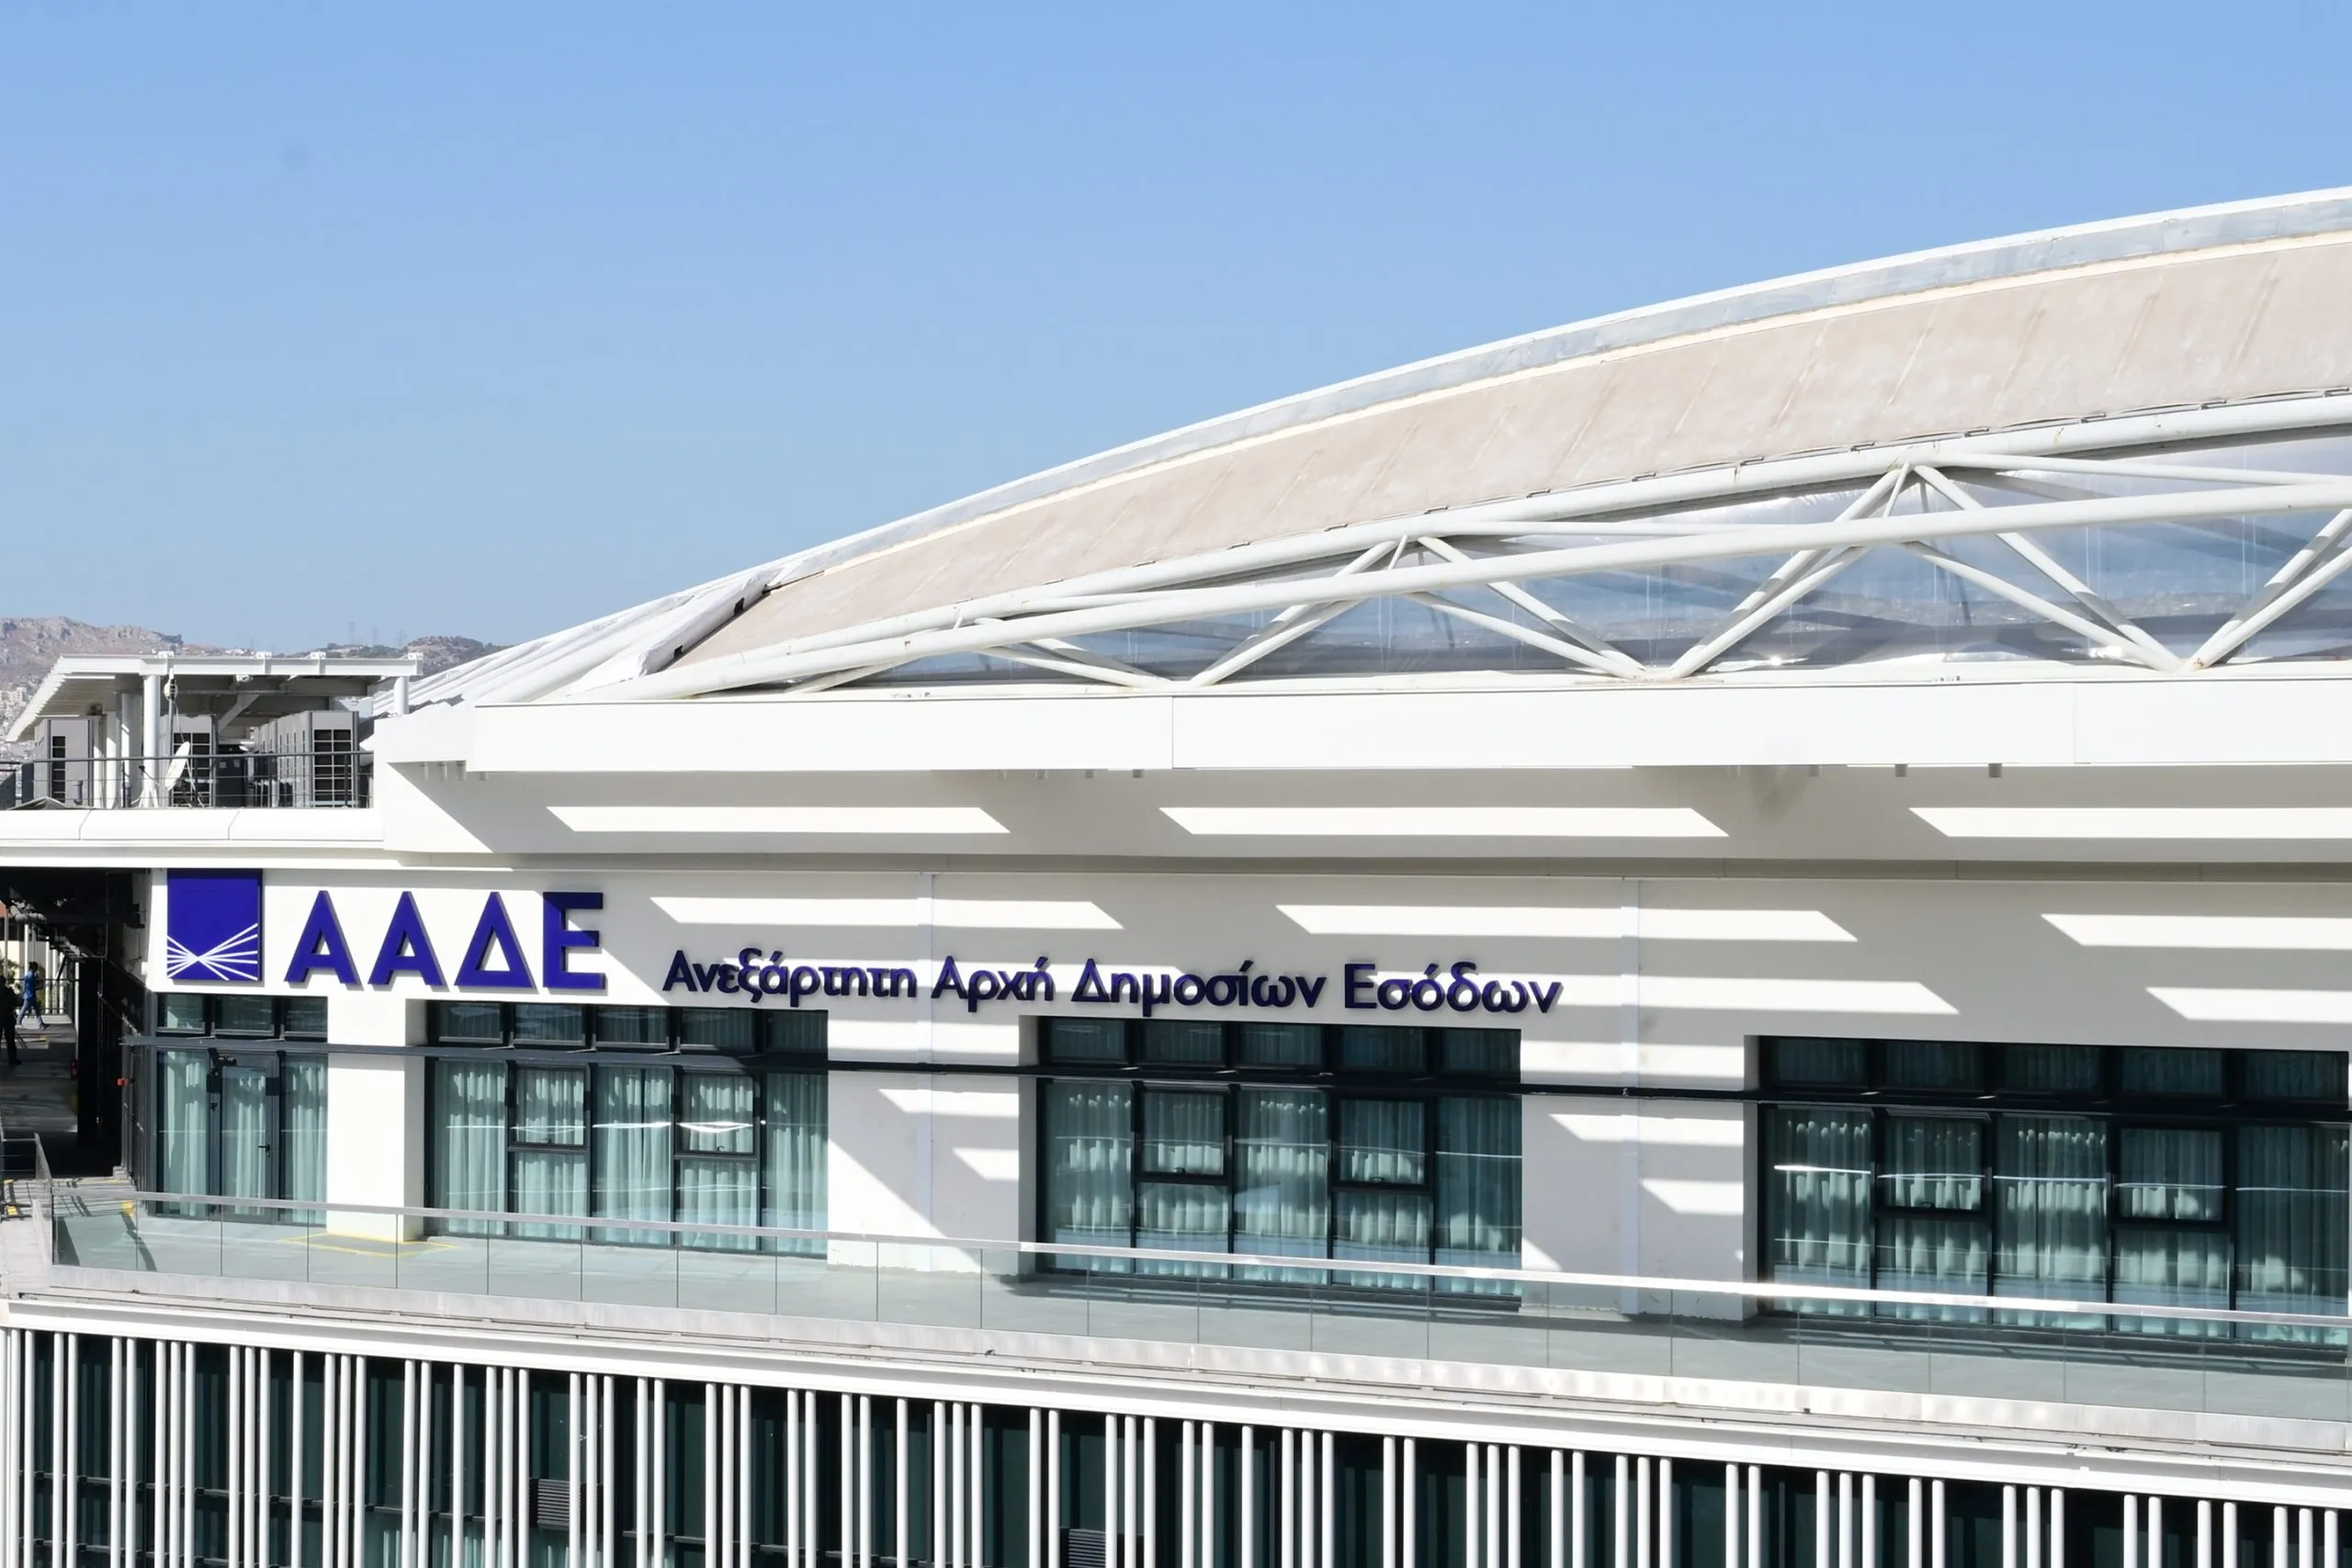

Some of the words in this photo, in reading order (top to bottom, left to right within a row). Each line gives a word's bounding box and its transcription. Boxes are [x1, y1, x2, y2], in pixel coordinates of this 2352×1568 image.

[284, 889, 606, 989] ΑΑΔΕ
[662, 948, 917, 1007] Ανεξάρτητη
[931, 955, 1054, 1012] Αρχή
[1071, 958, 1327, 1017] Δημοσίων
[1345, 961, 1562, 1013] Εσόδων
